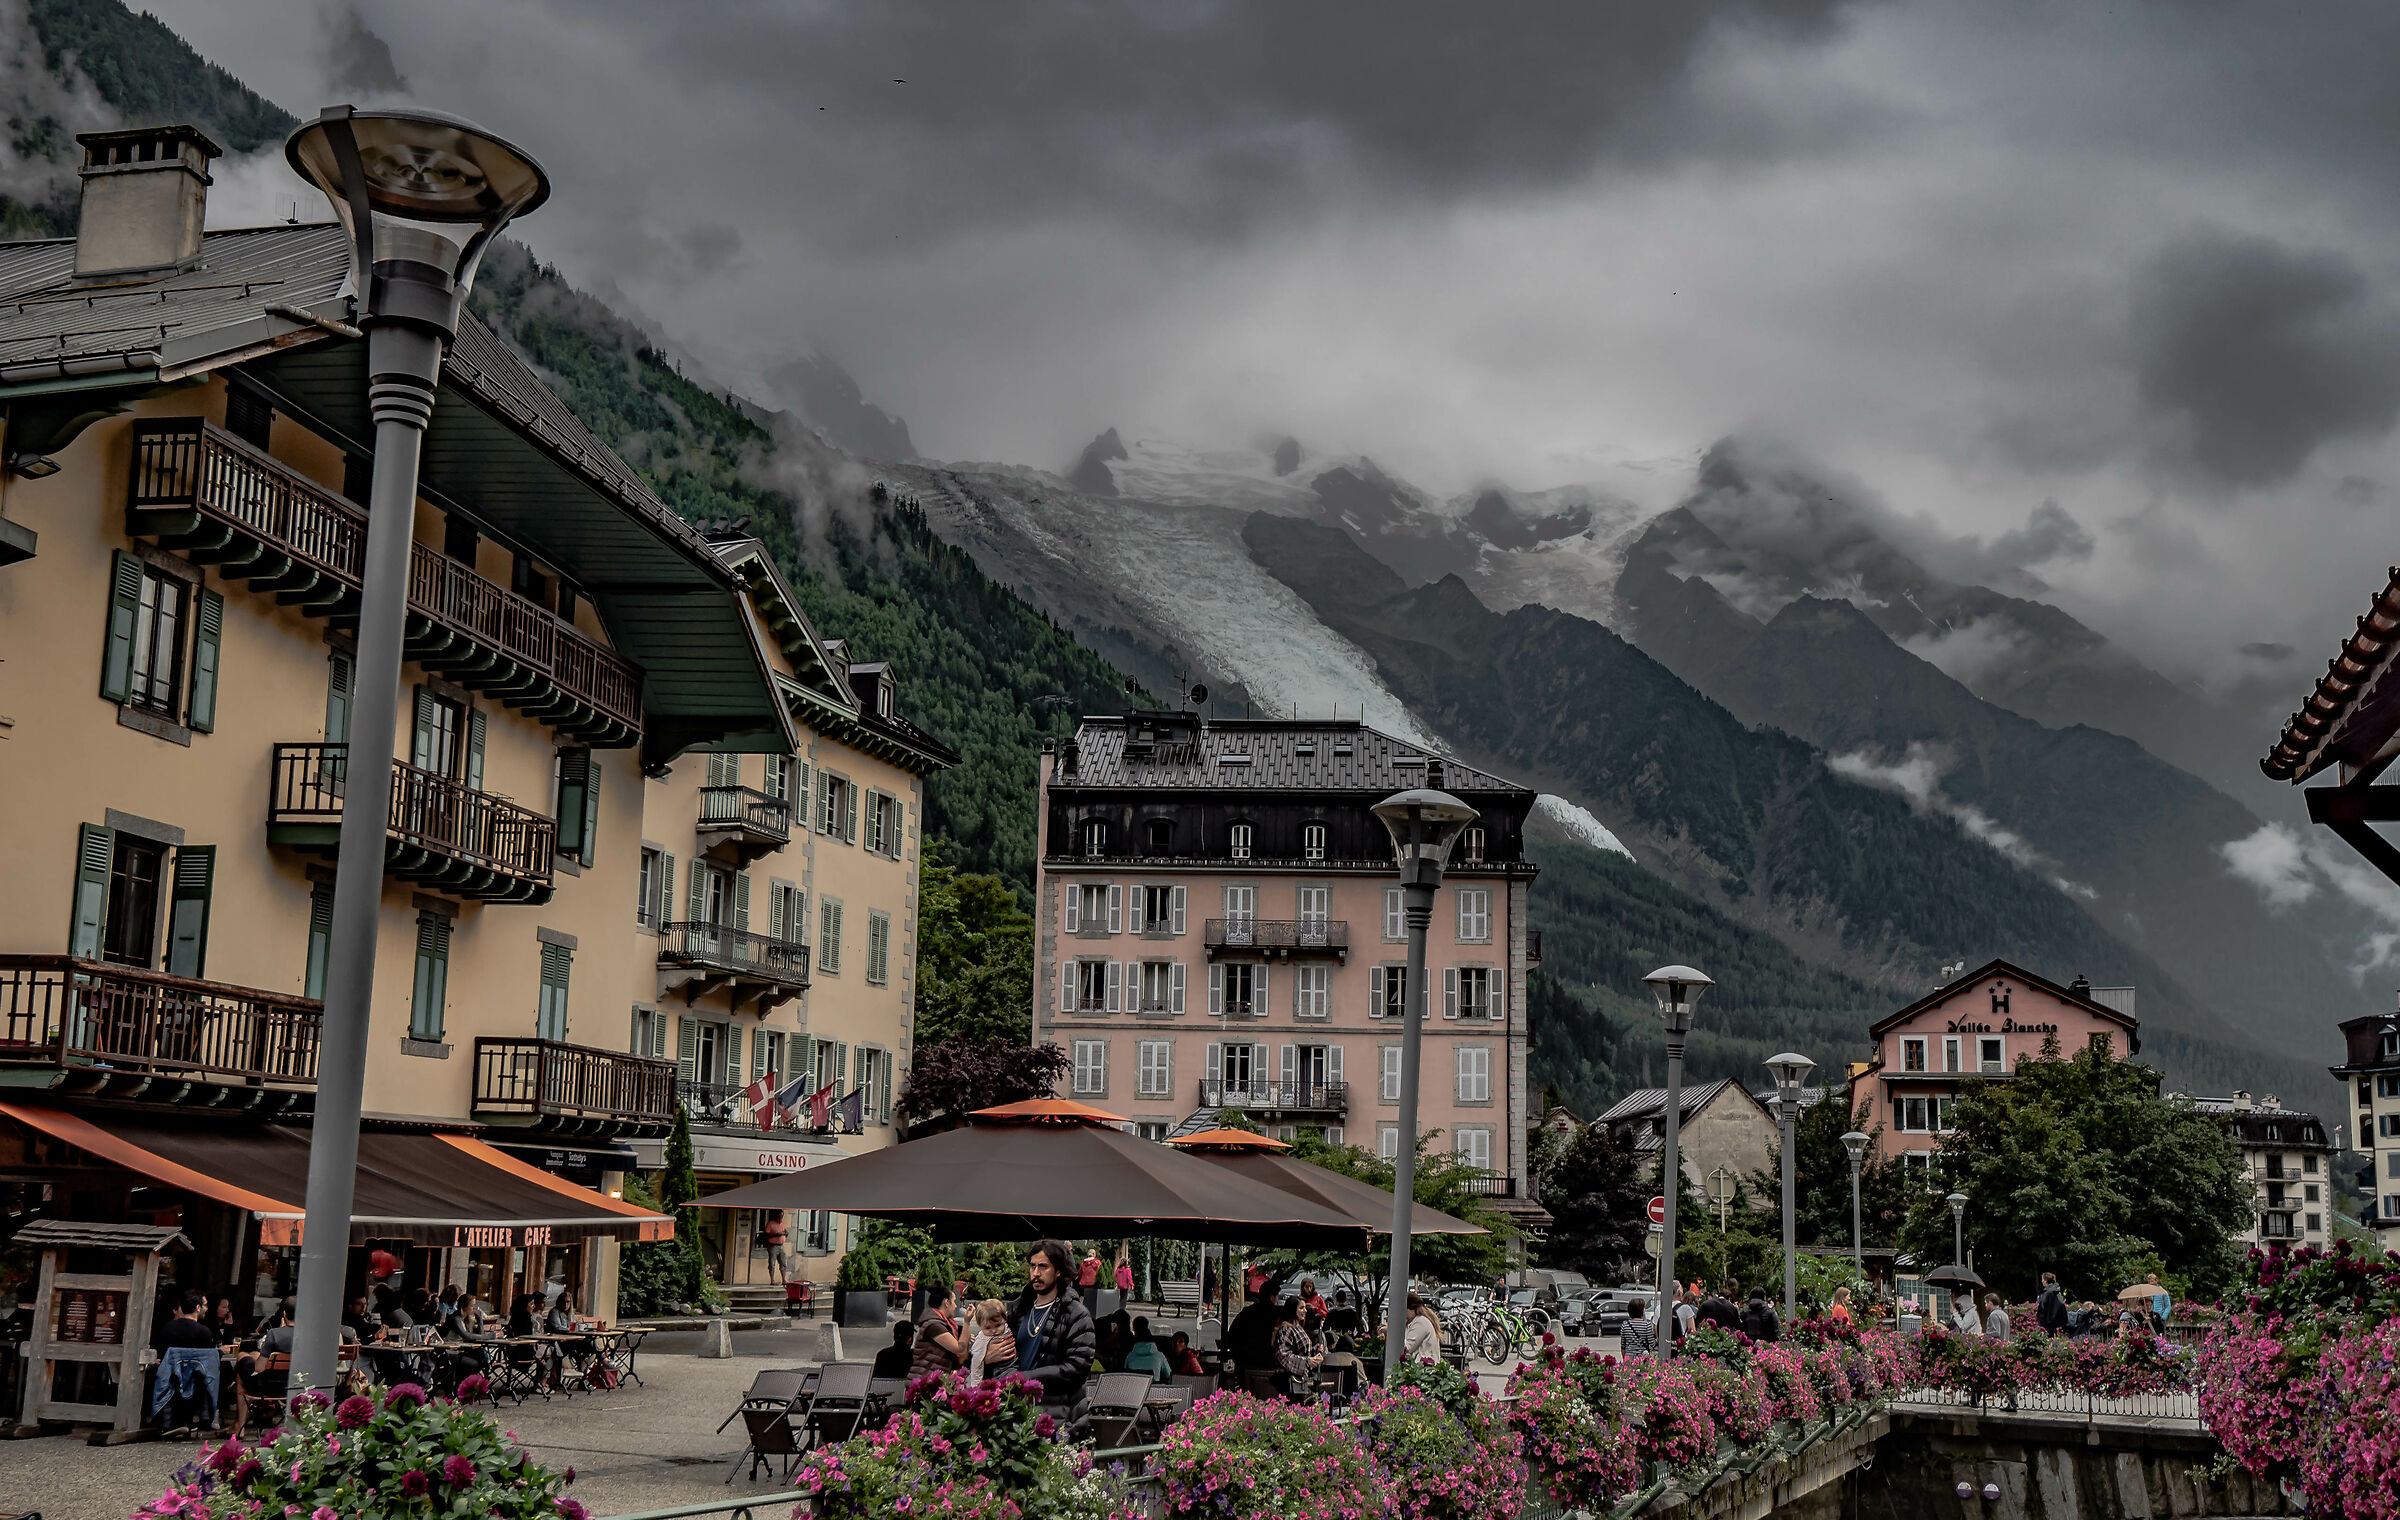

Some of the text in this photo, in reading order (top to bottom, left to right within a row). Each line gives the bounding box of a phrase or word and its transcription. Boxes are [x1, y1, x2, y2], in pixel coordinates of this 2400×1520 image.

[1991, 994, 2010, 1013] H
[1947, 1013, 2058, 1033] Vallée Blanche
[758, 1153, 807, 1169] CASINO
[454, 1224, 551, 1247] L'ATELIER CAFÉ
